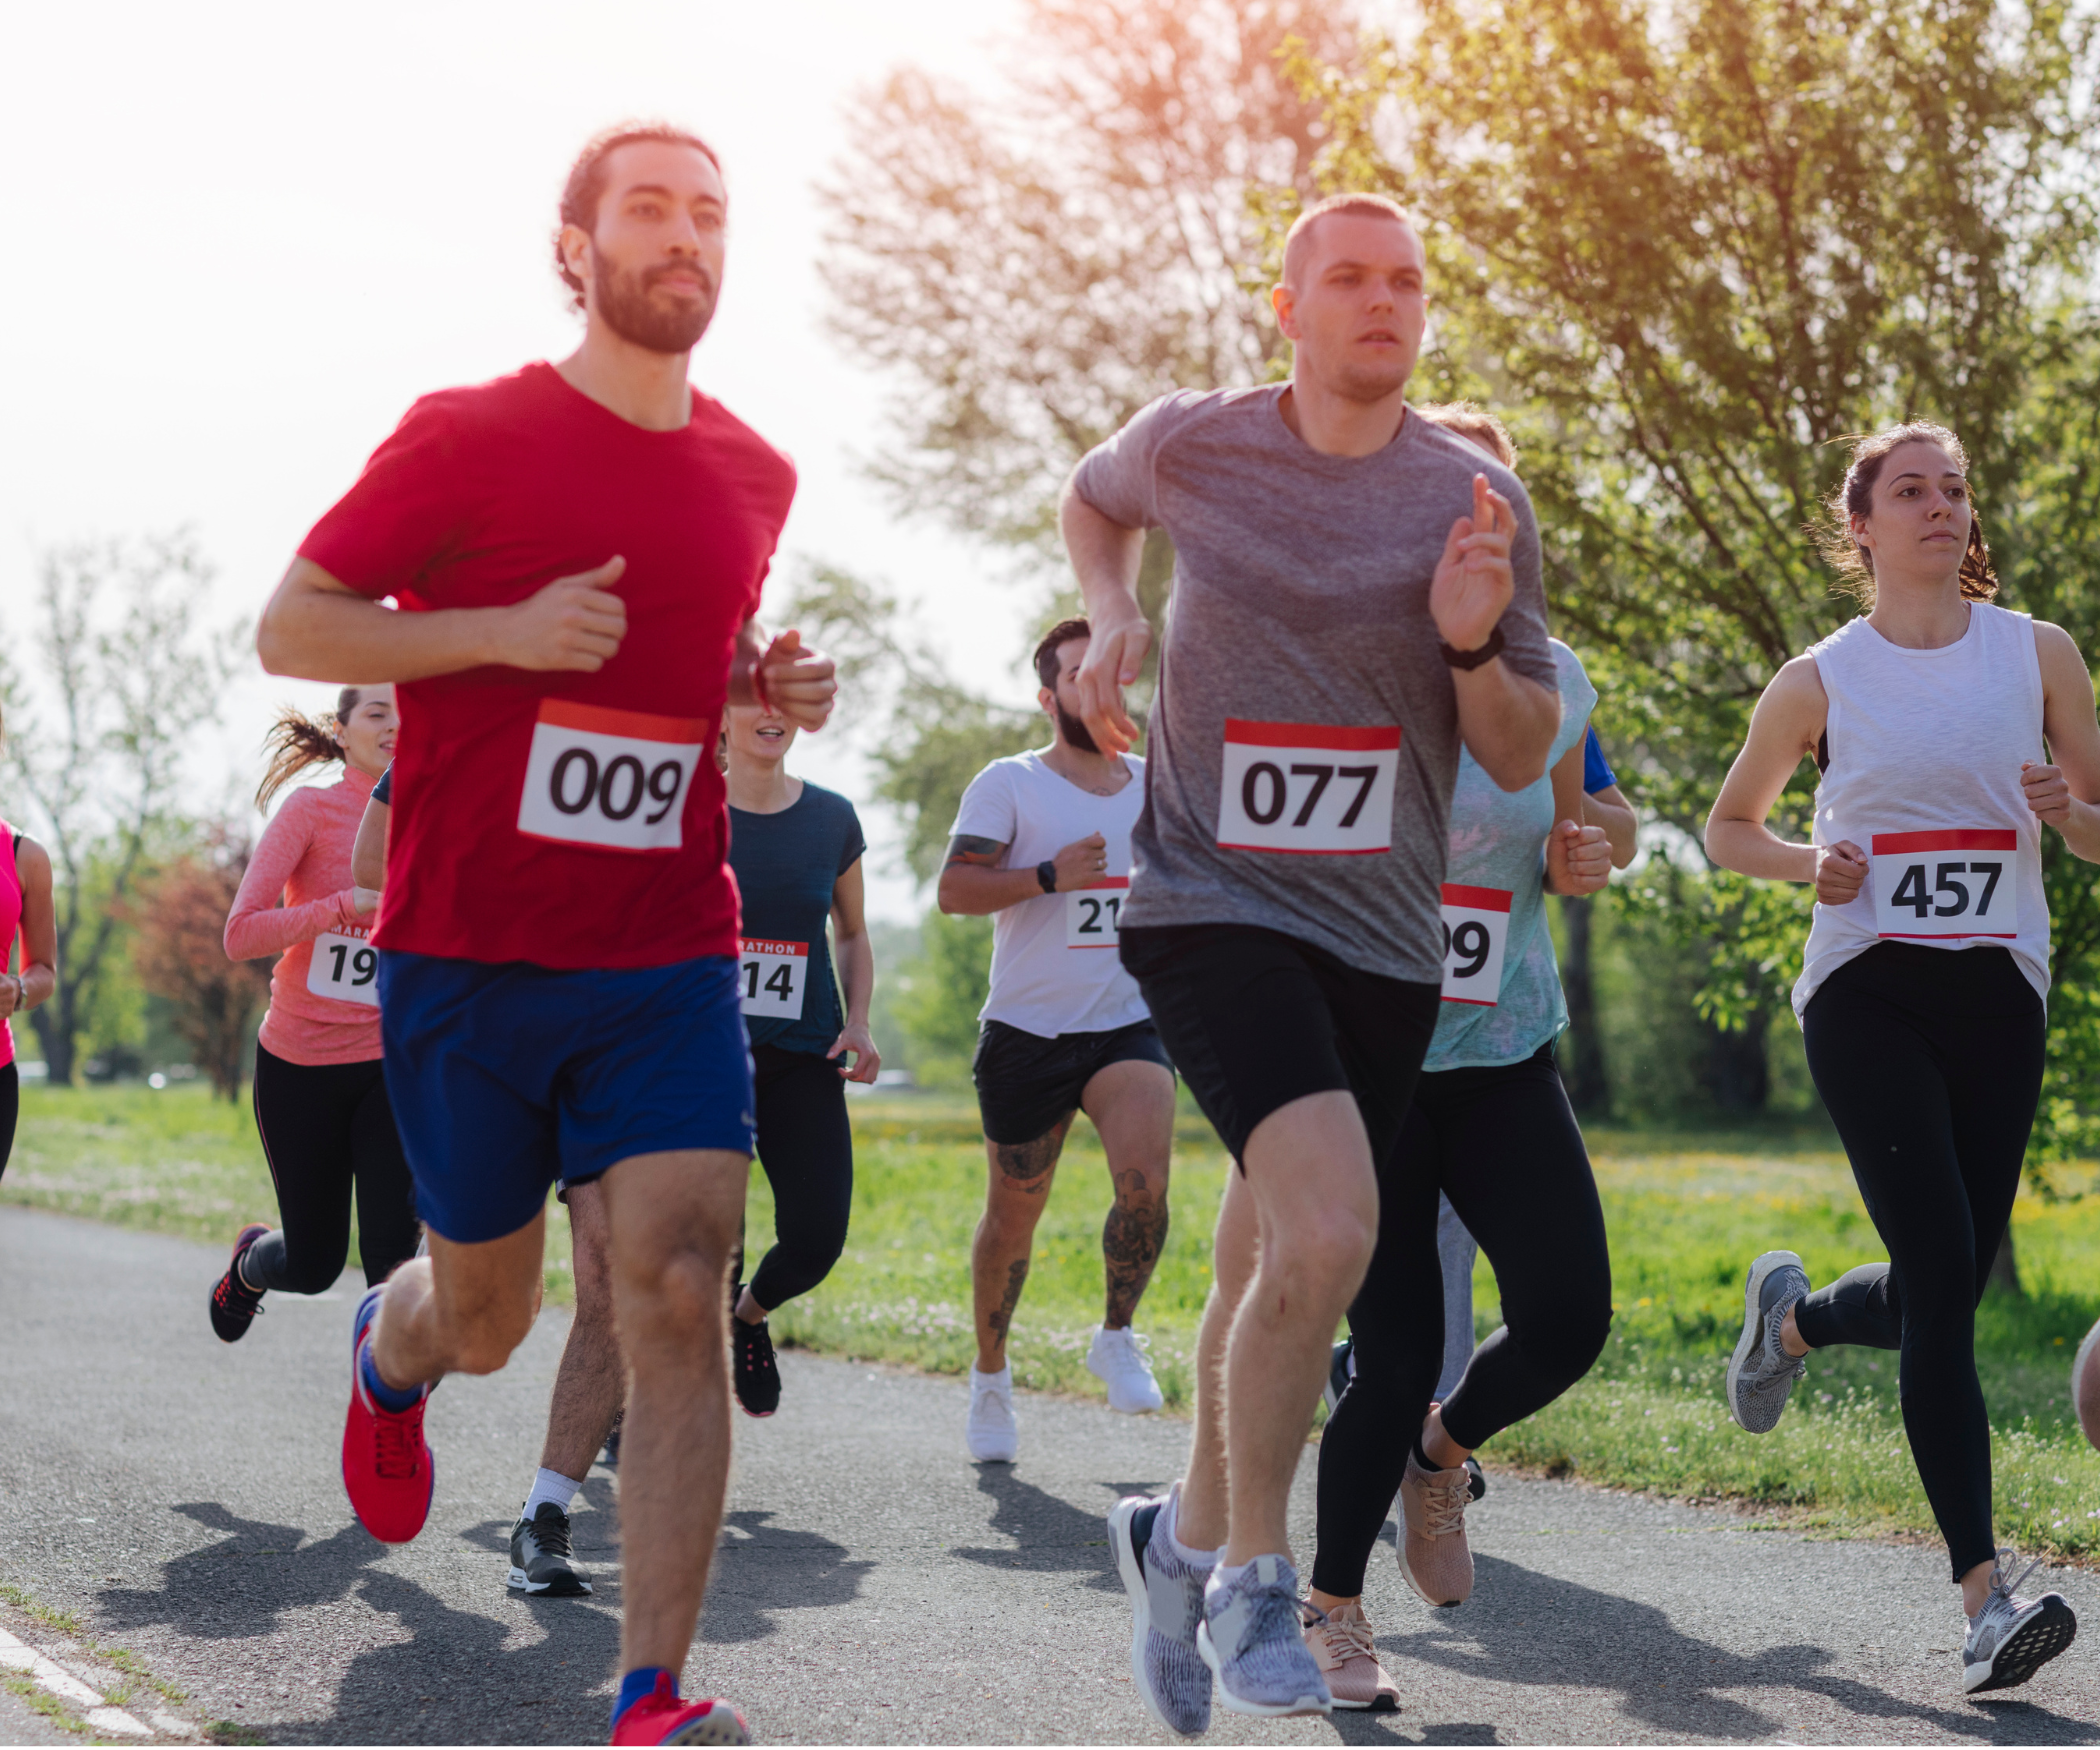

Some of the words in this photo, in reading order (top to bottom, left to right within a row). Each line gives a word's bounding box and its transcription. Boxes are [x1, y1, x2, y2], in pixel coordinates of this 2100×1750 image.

[550, 747, 682, 825] 009
[1242, 761, 1379, 828] 077
[1078, 897, 1120, 932] 21
[1891, 862, 2003, 918] 457
[329, 944, 378, 986] 19
[743, 961, 793, 1002] 14
